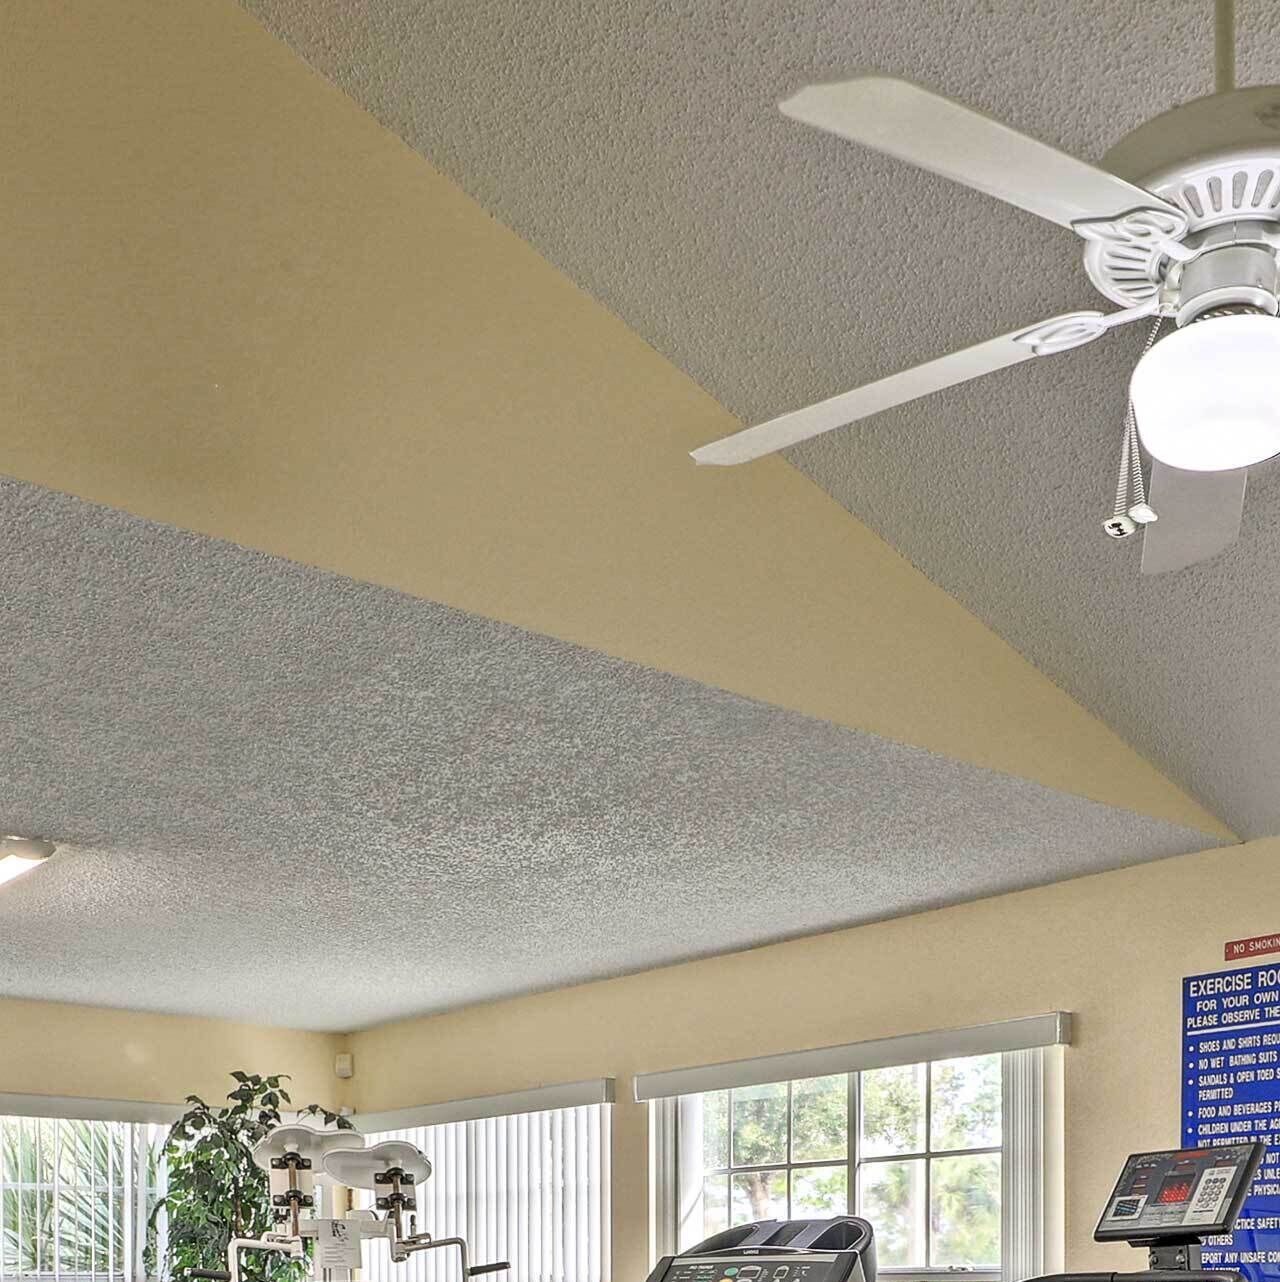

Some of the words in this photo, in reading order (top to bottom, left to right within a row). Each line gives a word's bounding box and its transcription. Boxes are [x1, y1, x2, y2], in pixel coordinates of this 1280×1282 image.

[1233, 944, 1245, 953] NO
[1190, 973, 1252, 997] EXERCISE
[1197, 999, 1217, 1012] FOR
[1222, 995, 1249, 1009] YOUR
[1254, 990, 1278, 1004] OWN
[1187, 1014, 1218, 1028] PLEASE
[1222, 1009, 1260, 1024] OBSERVE
[1264, 1006, 1280, 1018] THE
[1199, 1041, 1220, 1053] SHOES
[1222, 1038, 1235, 1050] AND
[1238, 1035, 1260, 1048] SHIRTS
[1199, 1059, 1208, 1070] NO
[1211, 1056, 1224, 1068] WET
[1229, 1052, 1256, 1067] BATHING
[1258, 1050, 1277, 1063] SUITS
[1198, 1073, 1228, 1087] SANDALS
[1237, 1070, 1255, 1083] OPEN
[1257, 1068, 1274, 1081] TOED
[1198, 1087, 1233, 1101] PERMITTED
[1198, 1105, 1215, 1119] FOOD
[1218, 1104, 1231, 1116] AND
[1233, 1101, 1272, 1115] BEVERAGES
[1198, 1122, 1228, 1135] CHILDREN
[1230, 1120, 1252, 1133] UNDER
[1254, 1119, 1267, 1130] THE
[1265, 1153, 1279, 1164] NOT
[1208, 1234, 1233, 1246] OTHERS
[1201, 1252, 1221, 1264] EPORT
[1225, 1252, 1238, 1263] ANY
[1239, 1251, 1265, 1263] UNSAFE
